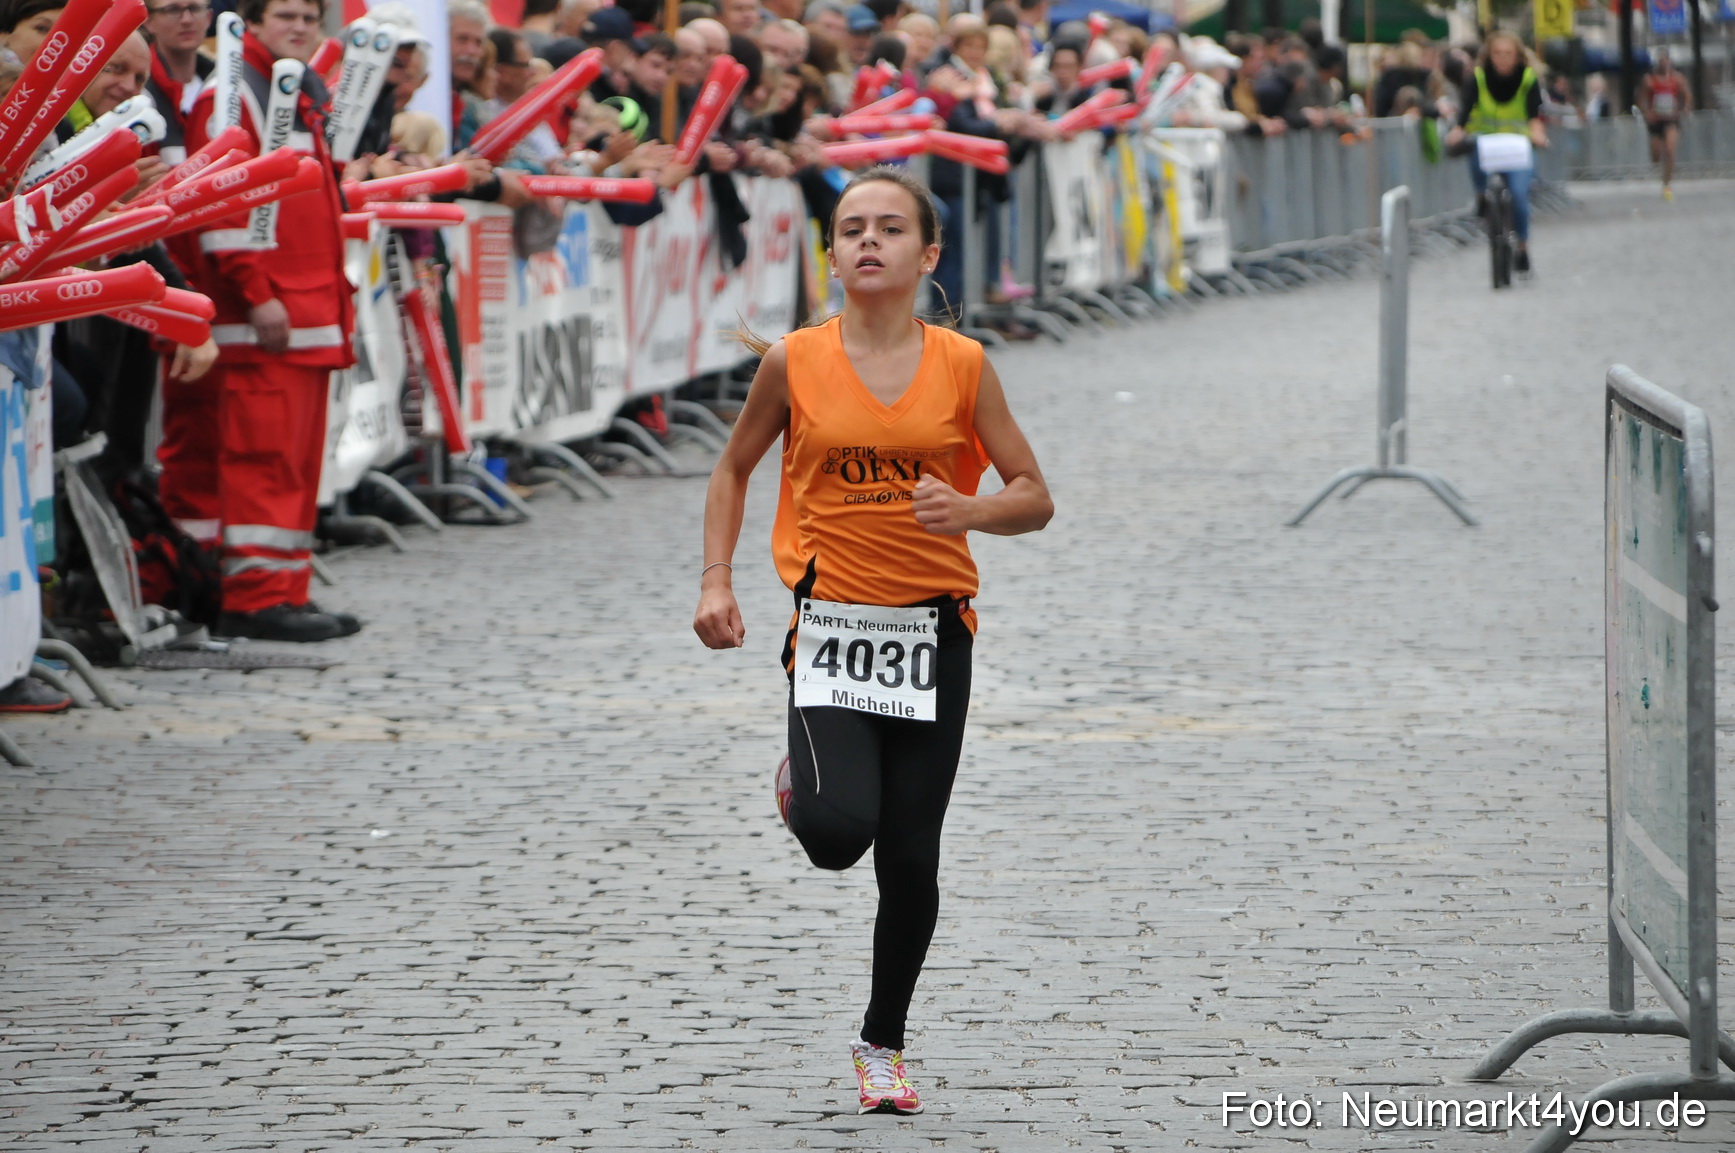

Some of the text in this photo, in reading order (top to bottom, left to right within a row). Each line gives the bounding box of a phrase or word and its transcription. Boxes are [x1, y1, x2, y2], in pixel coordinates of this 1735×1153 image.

[4, 82, 35, 120] BKK
[0, 289, 40, 308] BKK
[802, 612, 928, 634] PARTL Neumarkt
[812, 636, 937, 691] 4030
[832, 689, 915, 718] Michelle
